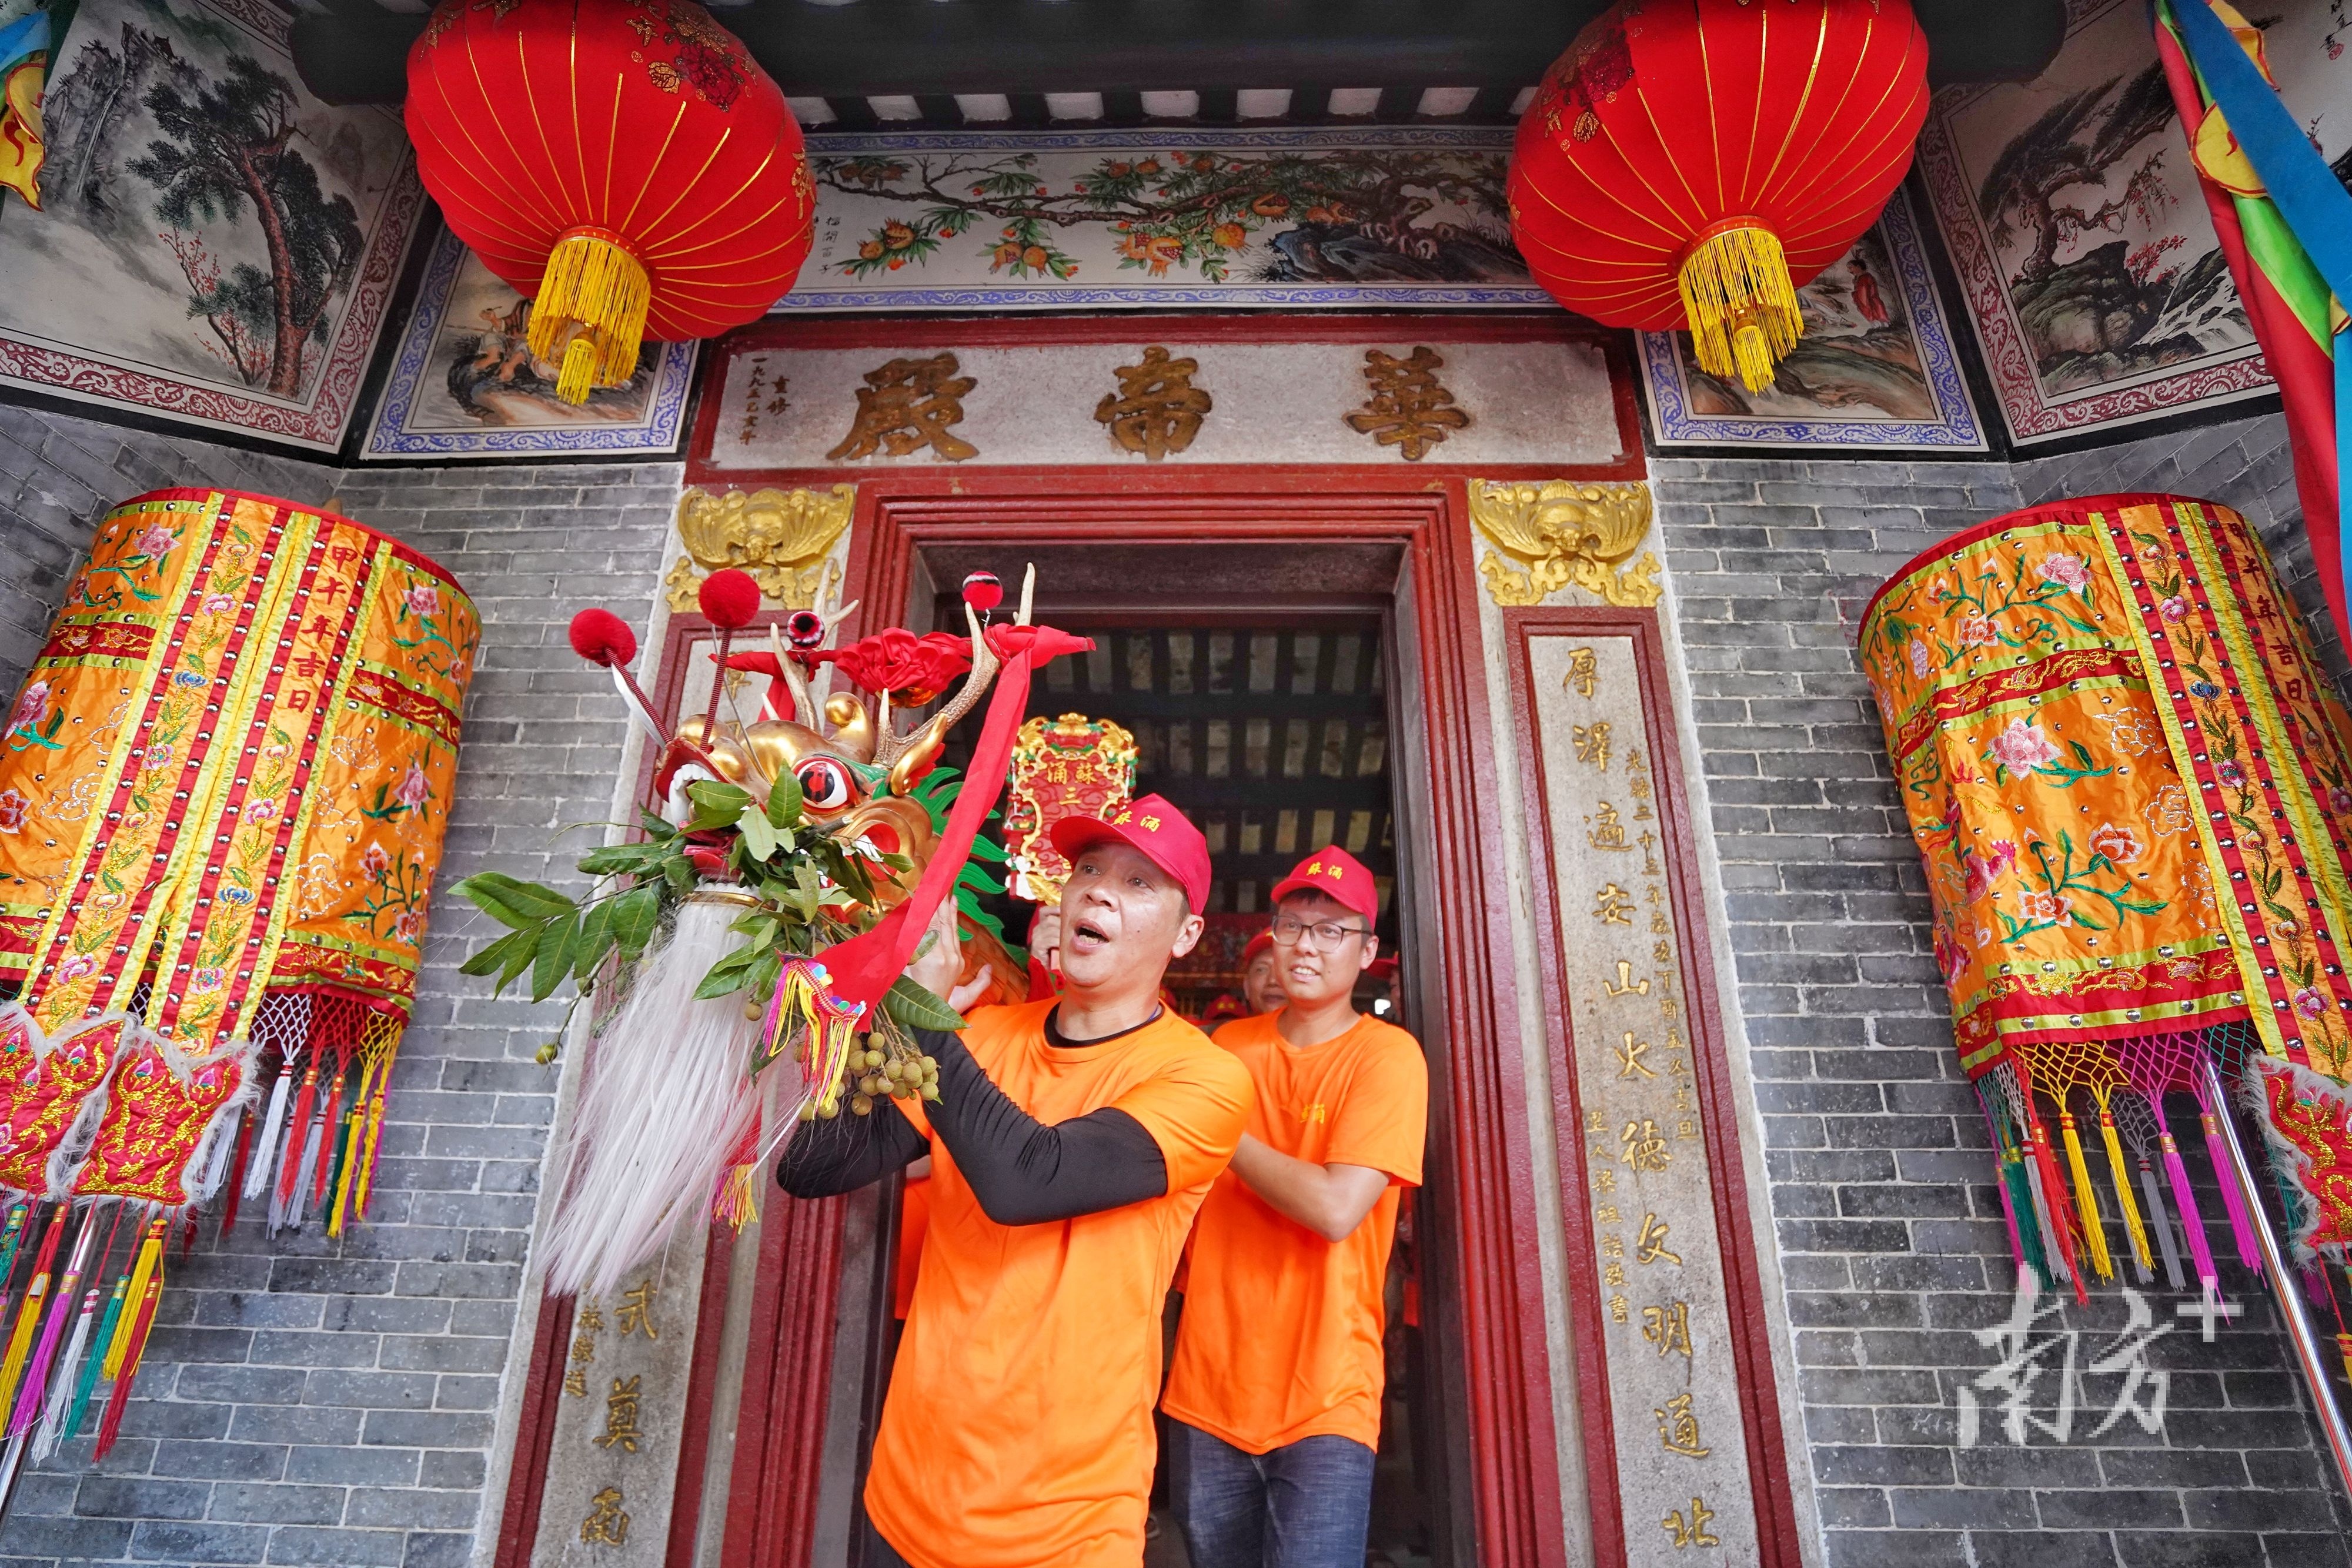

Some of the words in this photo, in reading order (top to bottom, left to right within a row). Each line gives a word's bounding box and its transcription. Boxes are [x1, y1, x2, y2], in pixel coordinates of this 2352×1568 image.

[766, 374, 791, 416] 重修
[287, 546, 358, 713] 甲午年吉日
[2227, 523, 2308, 703] 甲午年吉日
